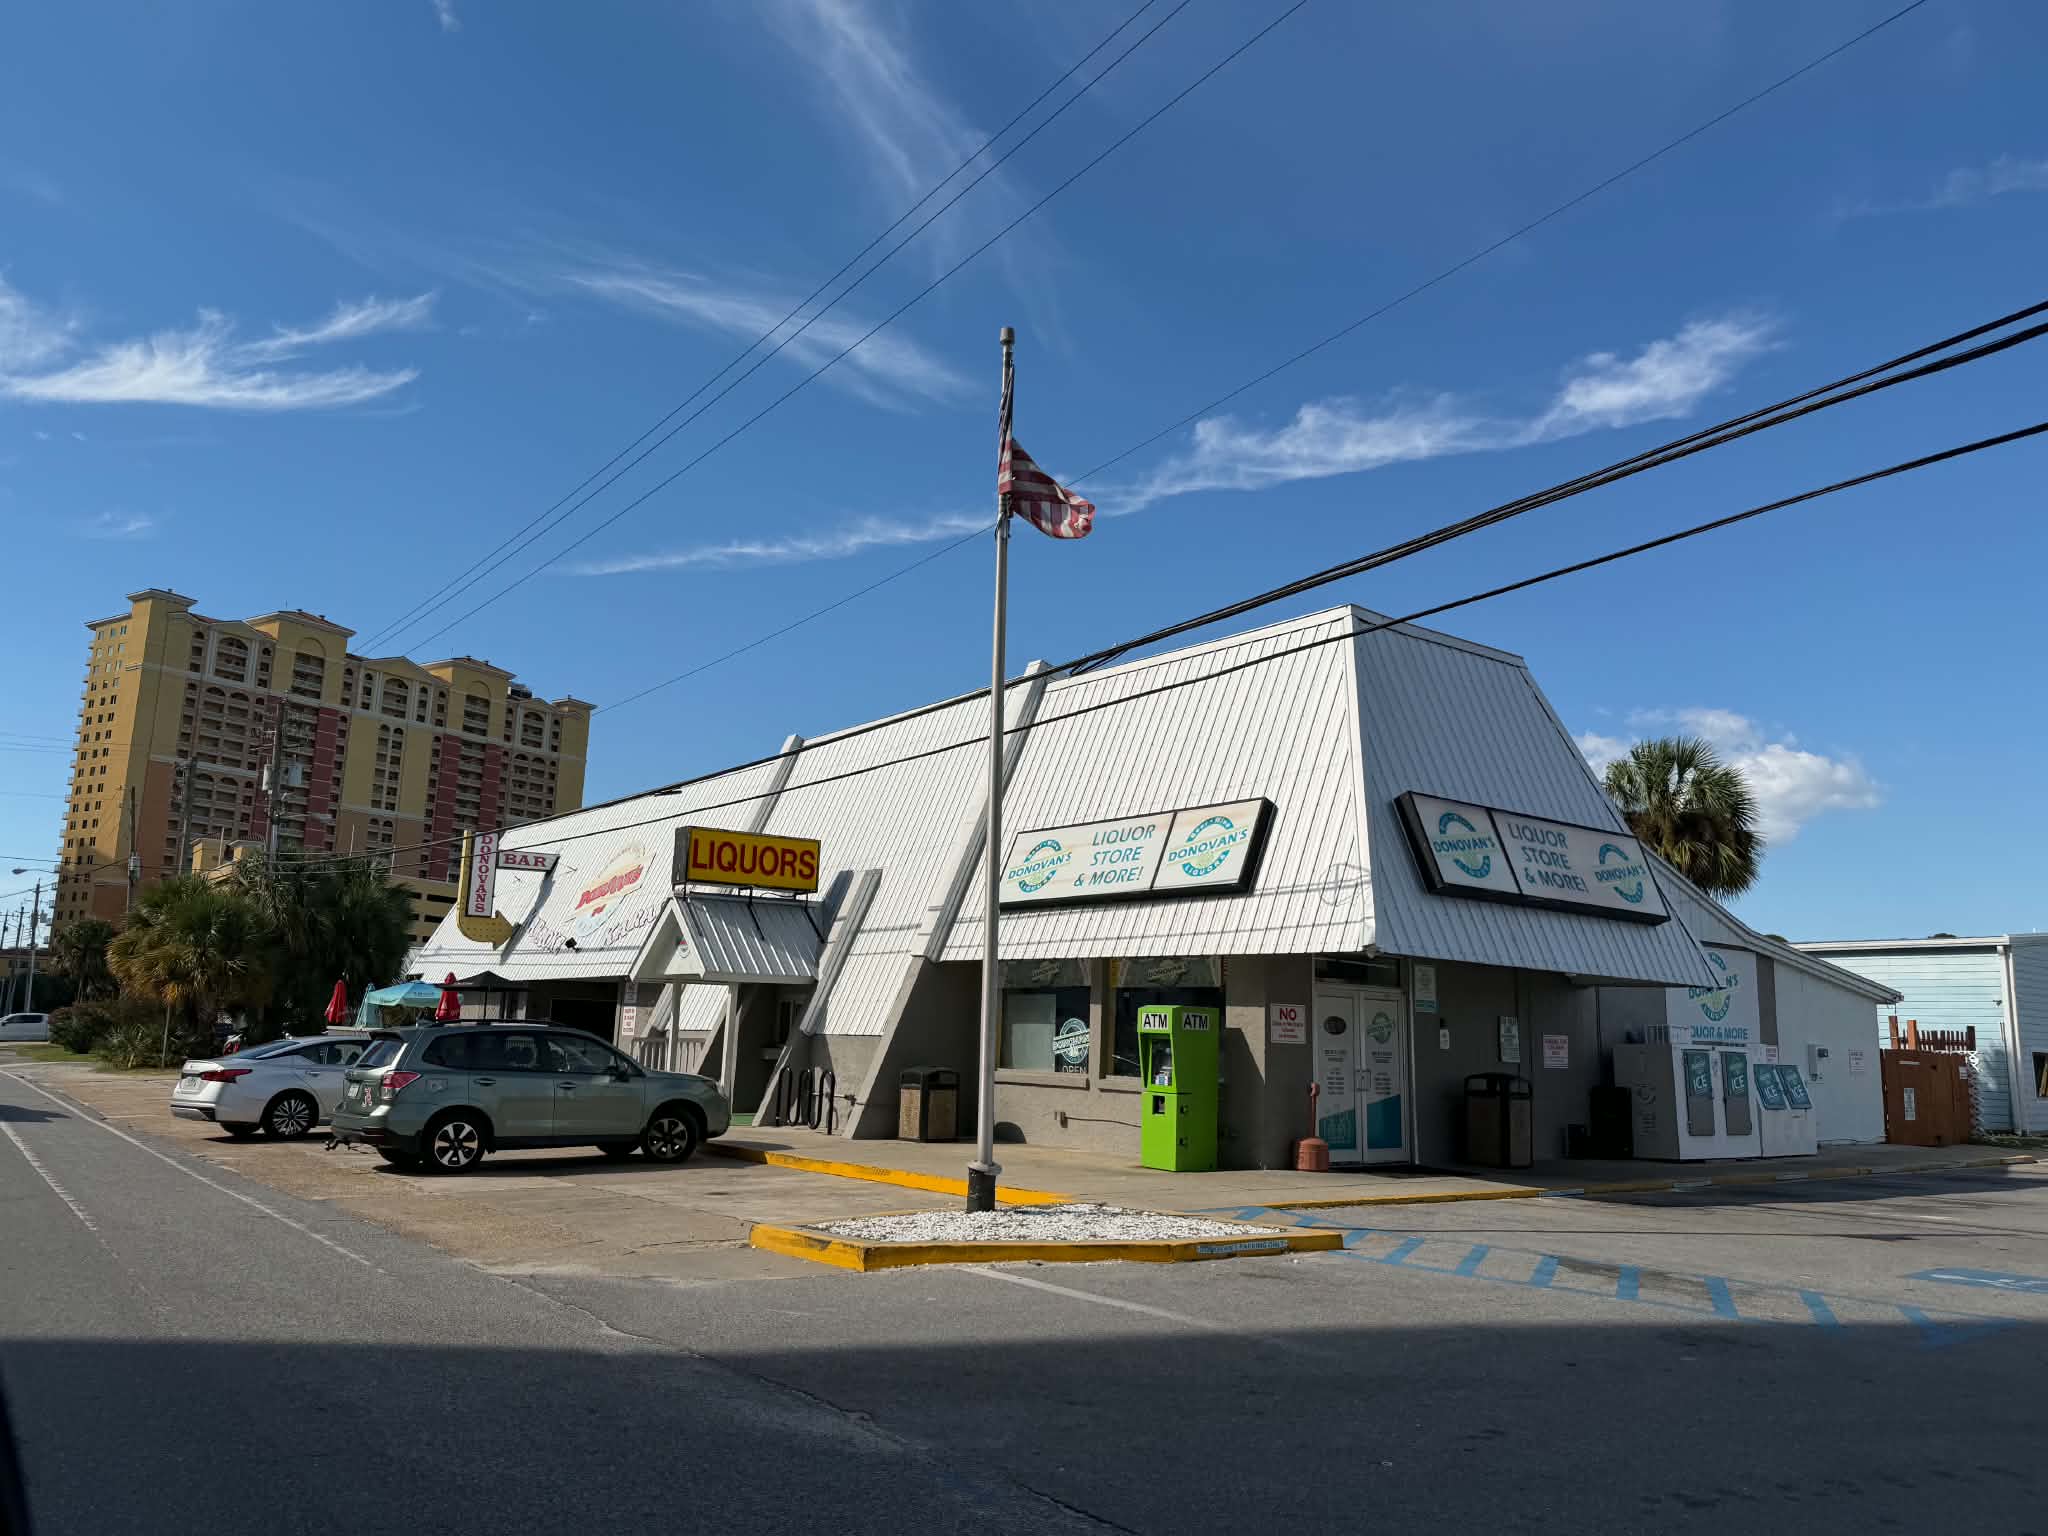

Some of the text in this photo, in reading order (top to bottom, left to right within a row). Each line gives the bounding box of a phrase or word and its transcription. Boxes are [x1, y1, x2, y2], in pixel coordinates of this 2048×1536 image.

[1092, 824, 1156, 846] LIQUOR
[1507, 823, 1568, 849] LIQUOR
[1168, 829, 1248, 862] DONOVAN'S
[1433, 836, 1496, 853] DONOVAN'S
[503, 853, 546, 867] BAR
[692, 838, 816, 880] LIQUORS
[1090, 846, 1144, 866] STORE
[1521, 846, 1572, 869] STORE
[475, 835, 493, 913] DONOVANS
[1007, 852, 1073, 880] DONOVAN'S
[1594, 864, 1647, 882] DONOVAN'S
[1073, 866, 1144, 887] & MORE!
[1524, 867, 1537, 885] &
[1537, 869, 1590, 894] MORE!
[1143, 1013, 1168, 1029] ATM
[1183, 1014, 1208, 1029] ATM
[1279, 1008, 1297, 1021] NO
[1724, 1026, 1749, 1040] MORE
[1693, 1074, 1708, 1090] ICE
[1731, 1074, 1745, 1090] ICE
[1791, 1084, 1806, 1098] ICE
[1764, 1085, 1778, 1099] ICE
